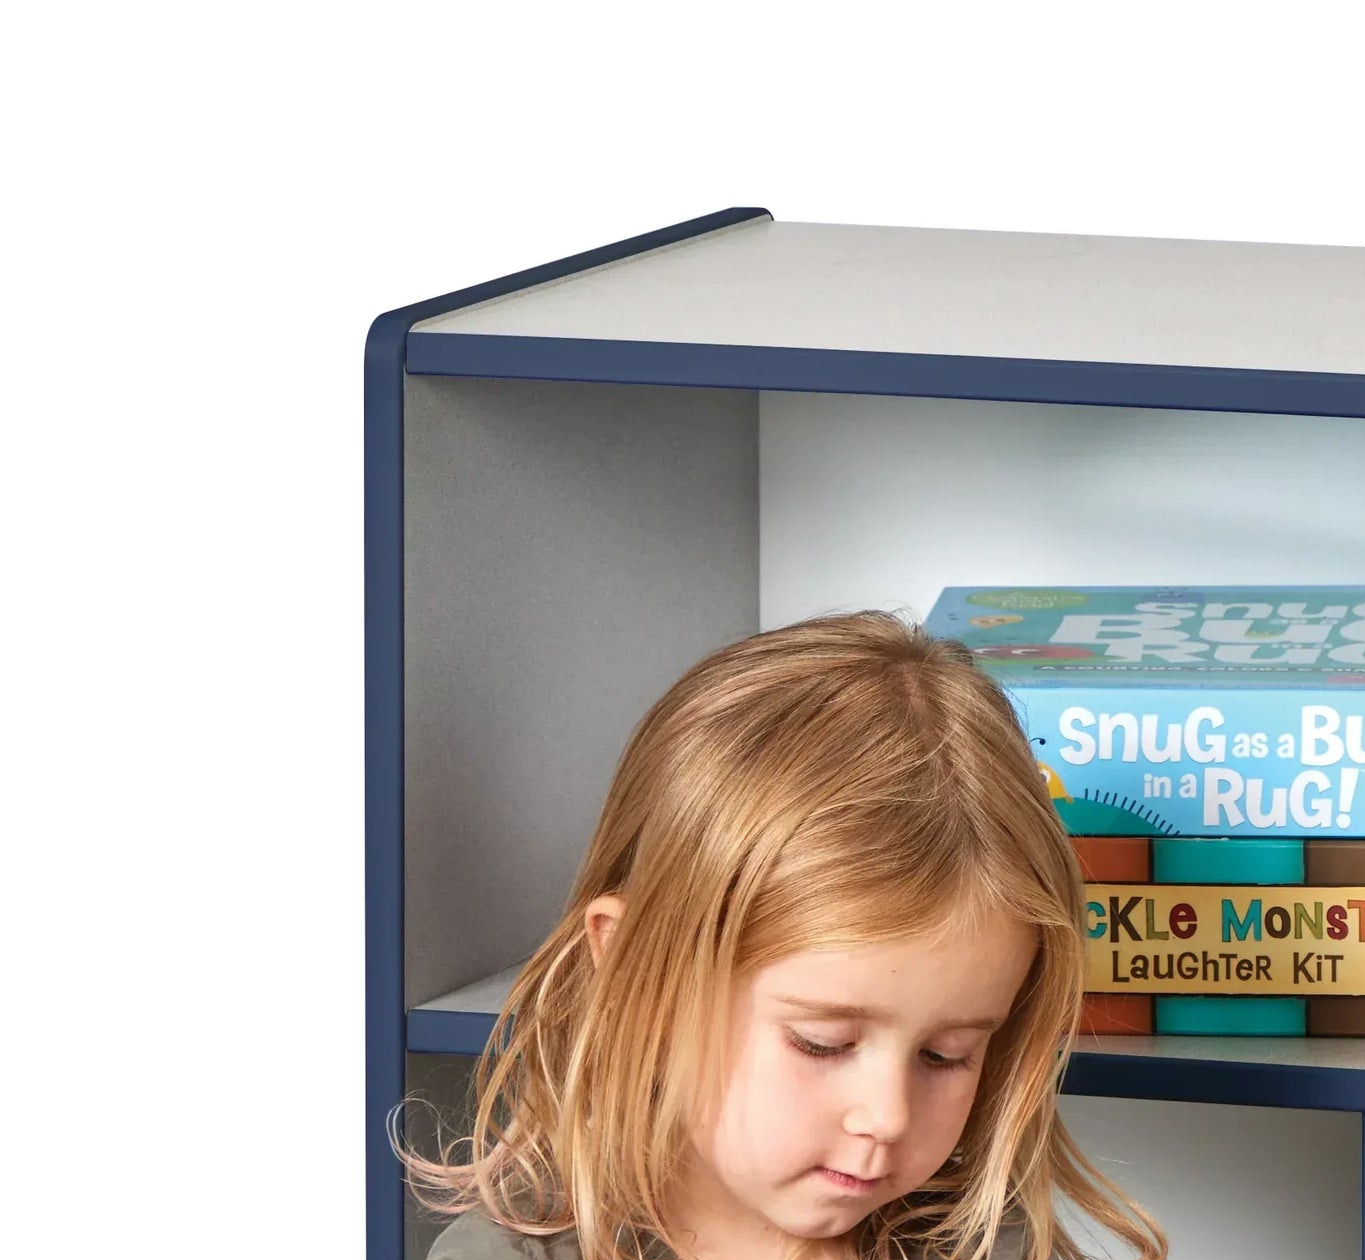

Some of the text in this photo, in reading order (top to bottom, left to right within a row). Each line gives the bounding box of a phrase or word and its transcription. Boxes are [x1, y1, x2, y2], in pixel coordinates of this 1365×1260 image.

[1232, 732, 1269, 759] as
[1276, 733, 1295, 759] a
[1143, 773, 1172, 799] in
[1179, 773, 1197, 799] a
